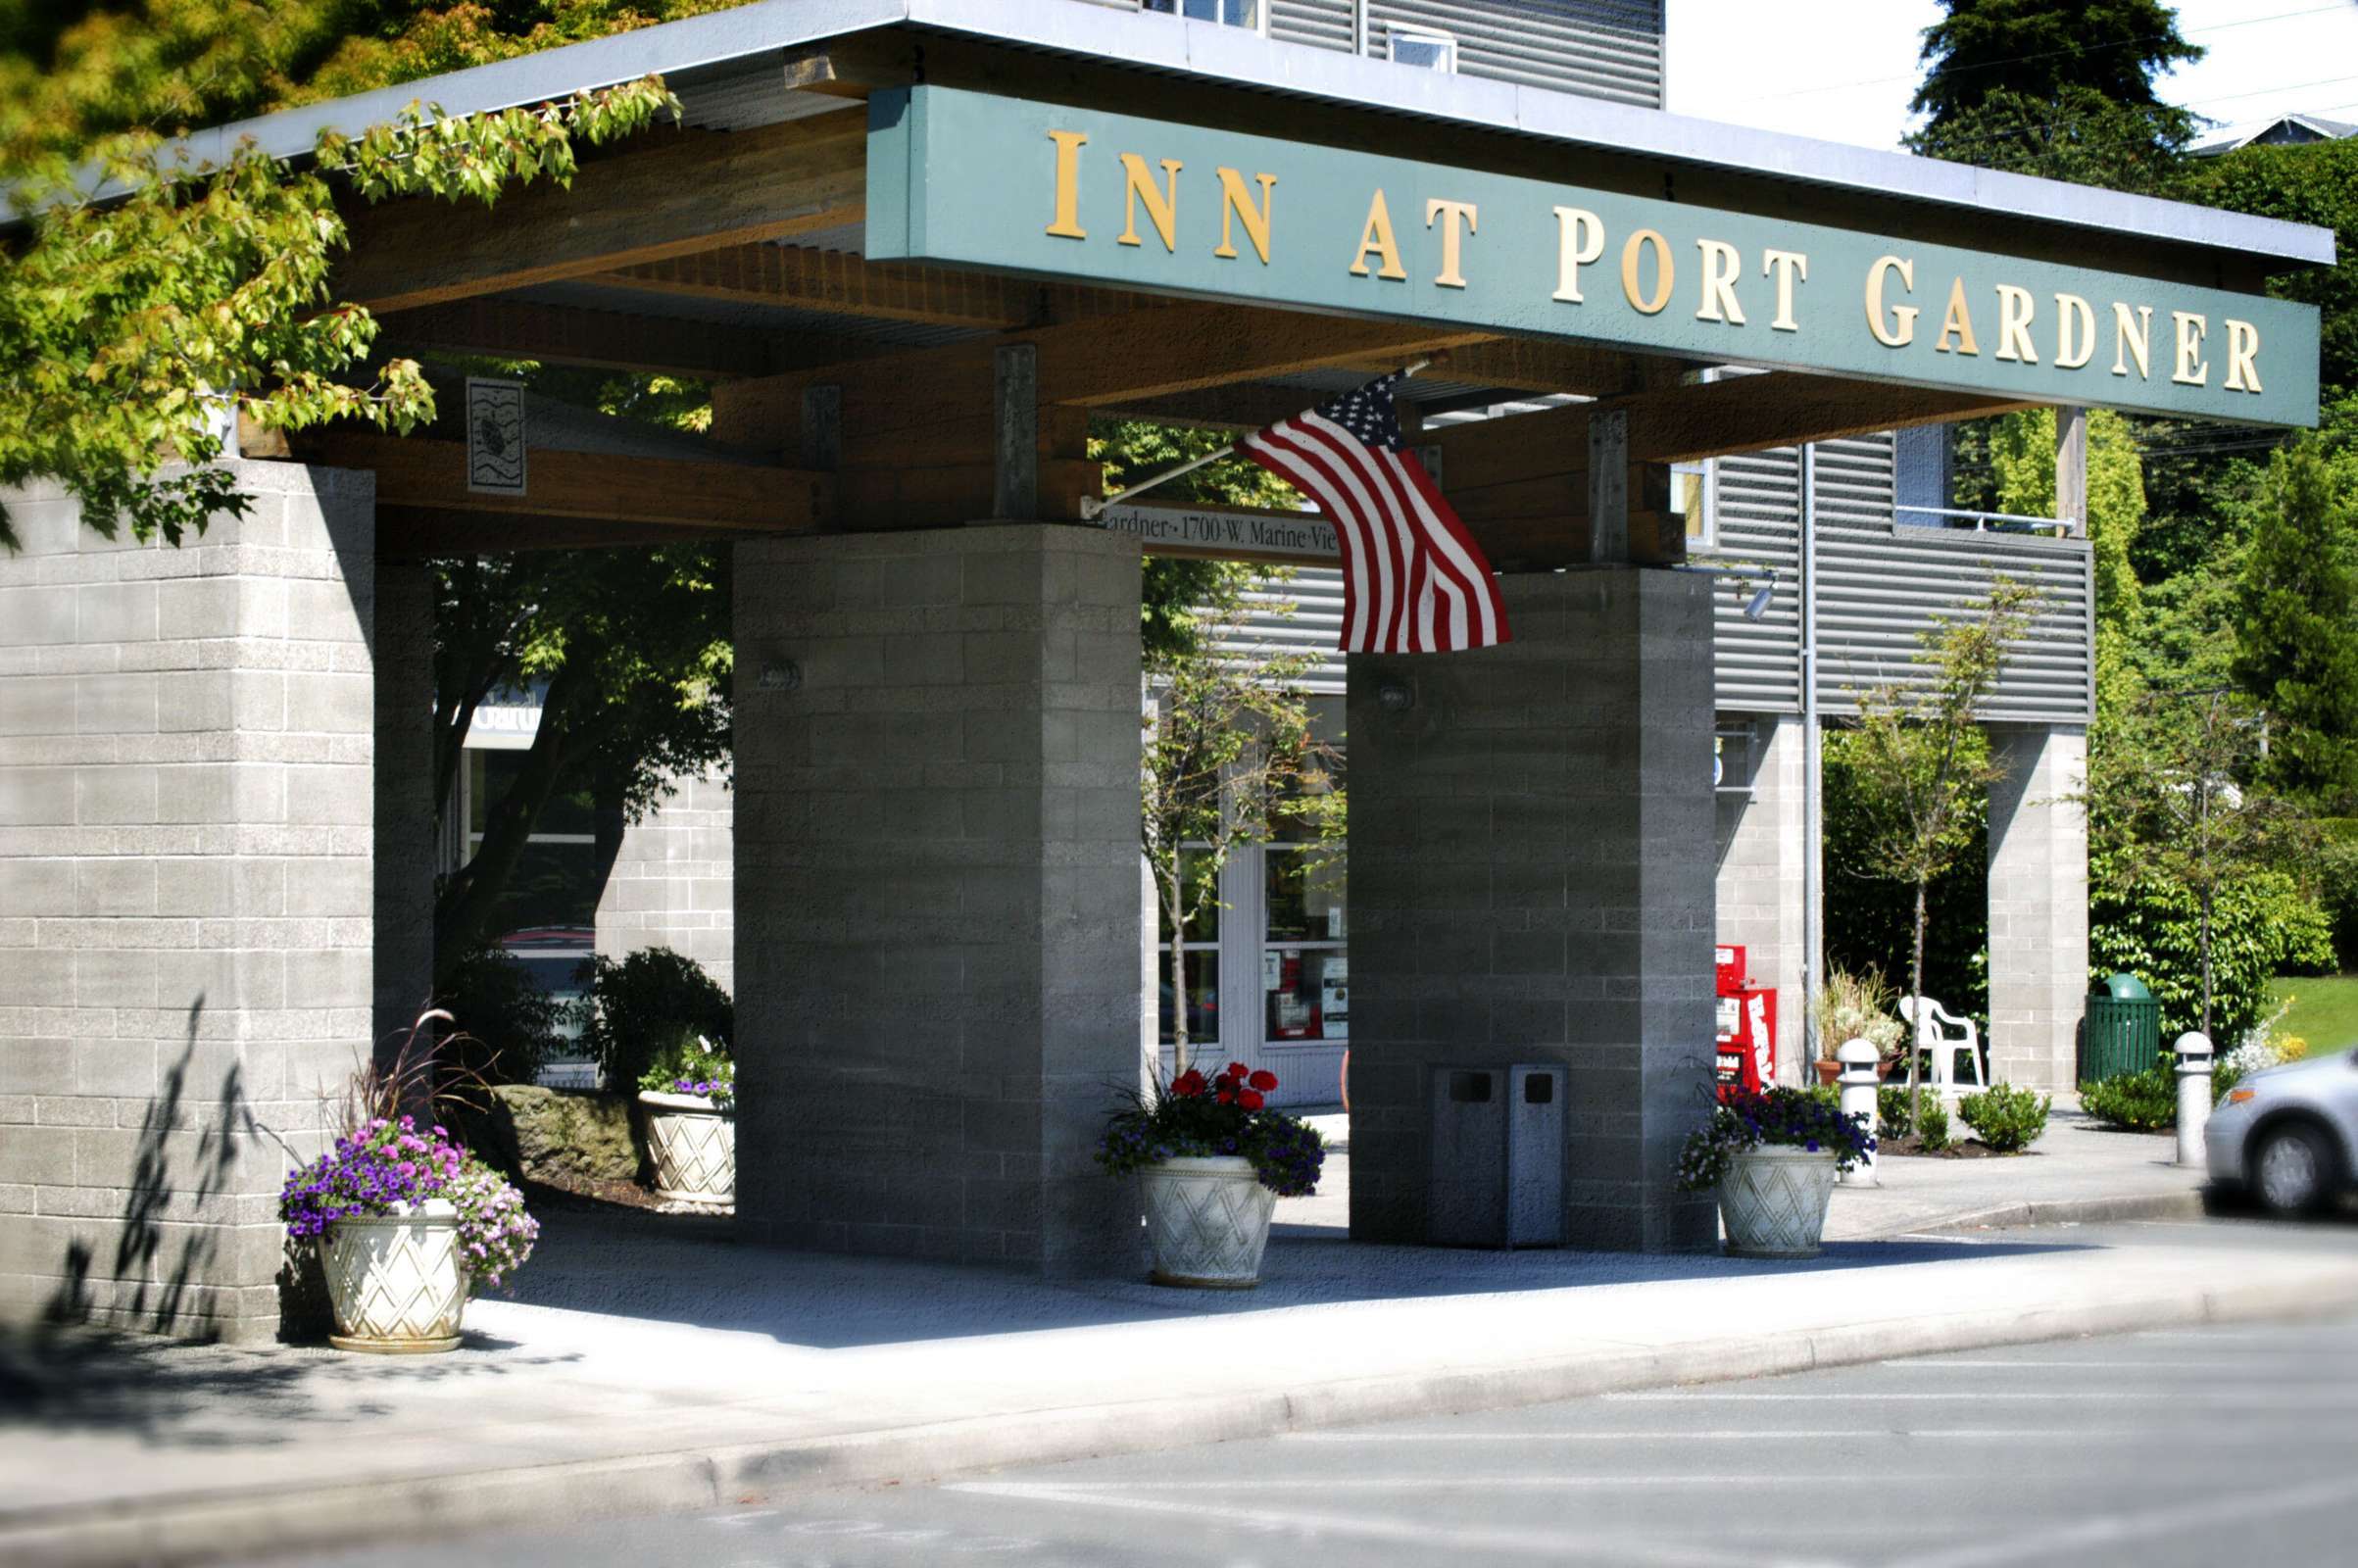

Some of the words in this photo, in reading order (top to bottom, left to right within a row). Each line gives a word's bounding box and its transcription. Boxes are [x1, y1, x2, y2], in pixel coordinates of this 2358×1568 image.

[1046, 128, 1277, 265] INN
[1349, 187, 1478, 289] AT
[1551, 205, 1807, 332] PORT
[1864, 255, 2263, 394] GARDNER
[1103, 509, 1168, 538] ardner
[1182, 515, 1220, 542] 1700
[1225, 518, 1245, 544] W.
[1250, 519, 1305, 549] Marine
